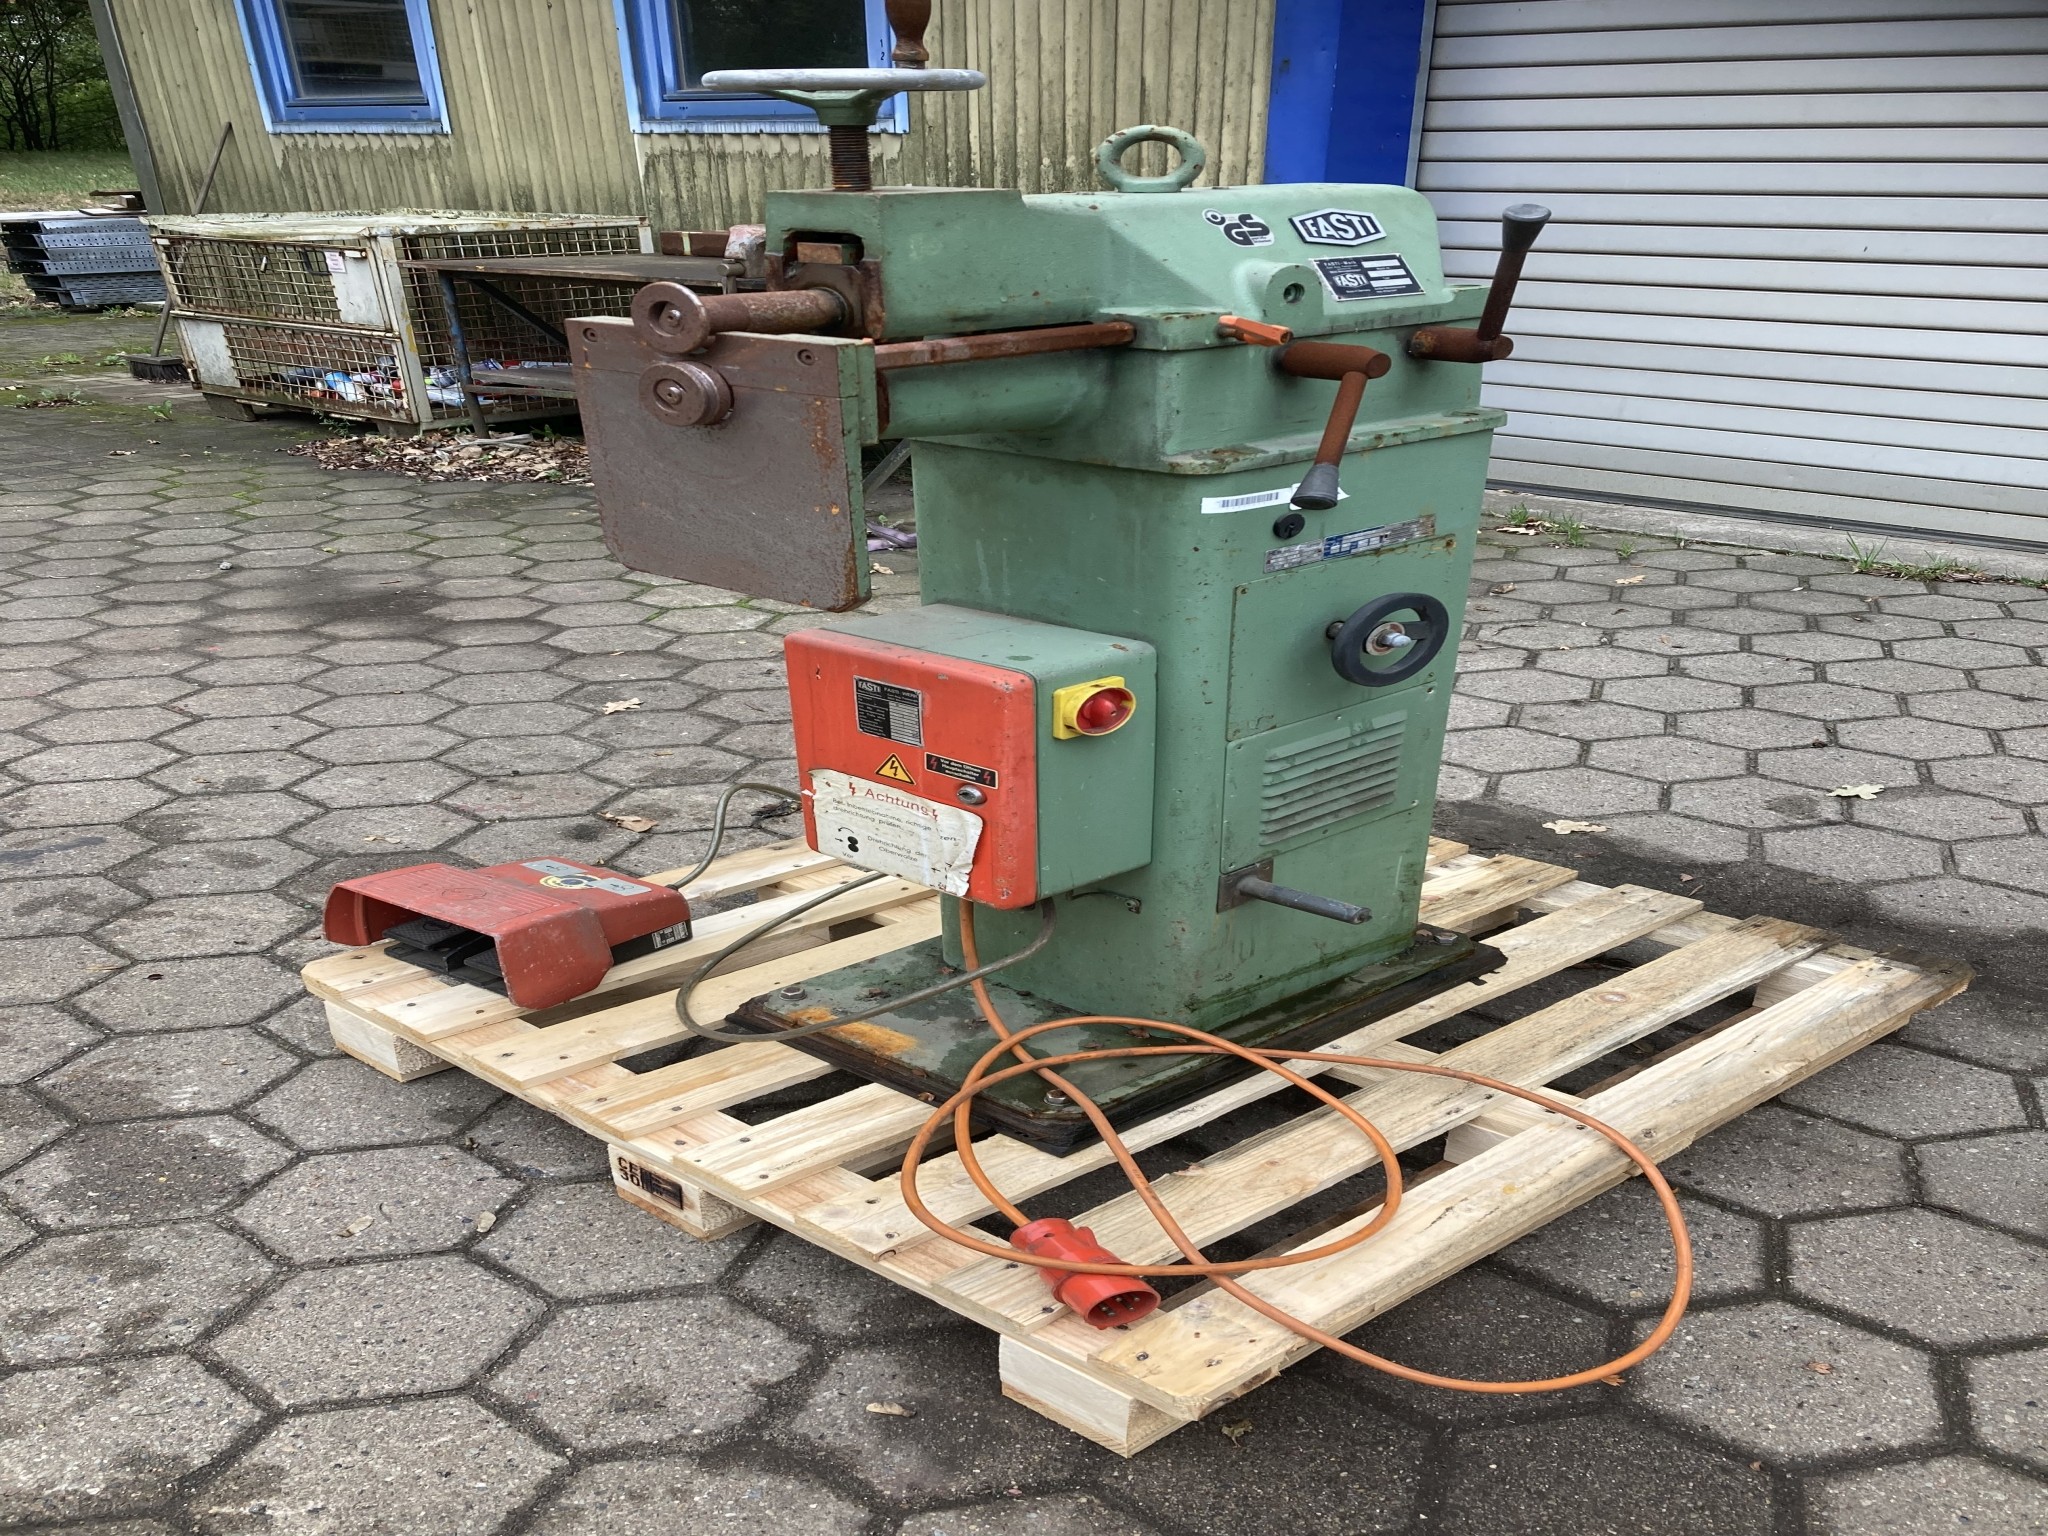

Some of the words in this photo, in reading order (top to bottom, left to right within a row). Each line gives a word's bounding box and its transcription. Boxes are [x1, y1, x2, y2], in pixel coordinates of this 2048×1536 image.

[1304, 213, 1376, 240] FASTI
[1334, 273, 1368, 289] FASTI
[864, 788, 930, 816] Achtung
